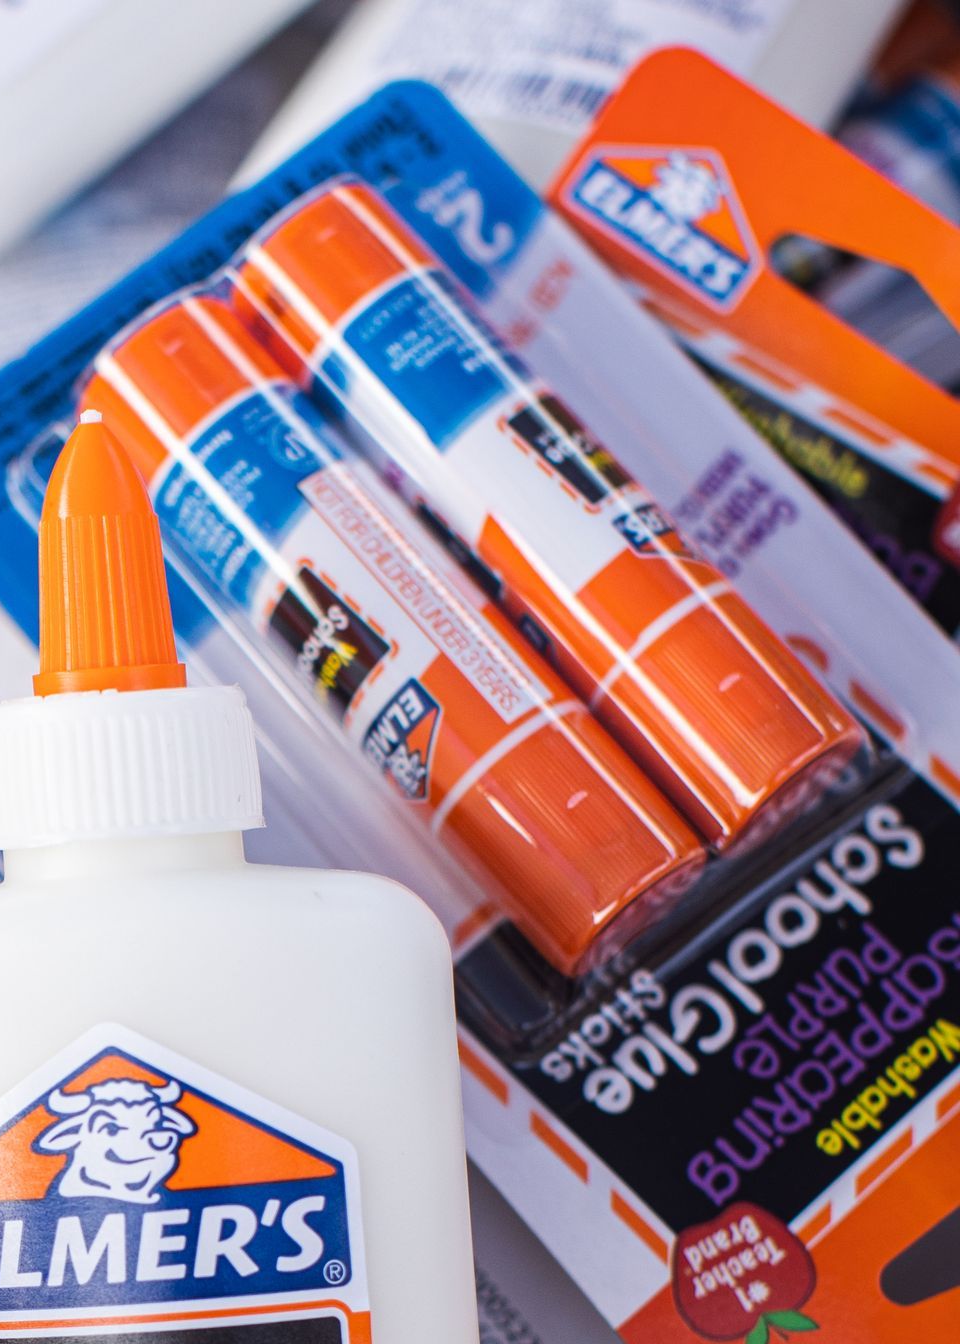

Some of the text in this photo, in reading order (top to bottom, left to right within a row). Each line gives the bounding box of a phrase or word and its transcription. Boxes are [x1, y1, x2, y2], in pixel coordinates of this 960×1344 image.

[583, 804, 924, 1114] School Glue
[541, 968, 666, 1082] Sticks
[816, 1018, 960, 1155] Washable
[683, 1214, 762, 1273] Brand
[692, 1236, 787, 1299] Teacher
